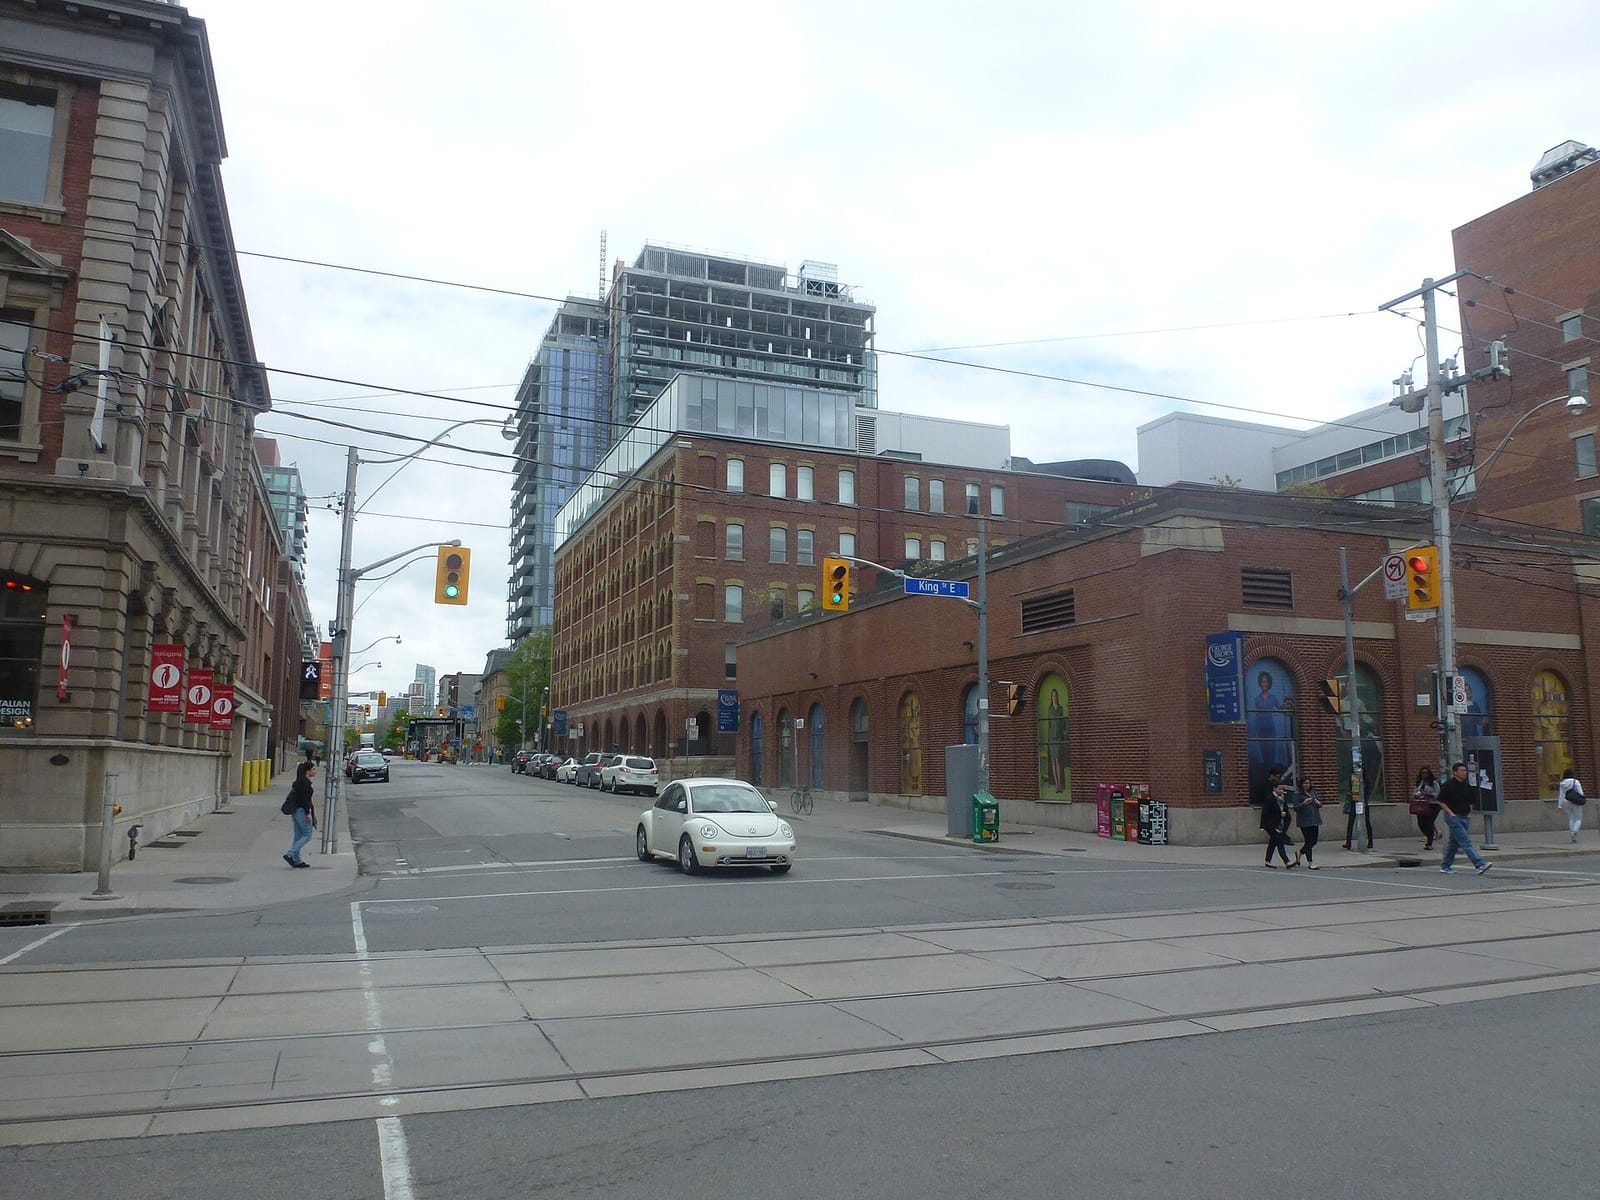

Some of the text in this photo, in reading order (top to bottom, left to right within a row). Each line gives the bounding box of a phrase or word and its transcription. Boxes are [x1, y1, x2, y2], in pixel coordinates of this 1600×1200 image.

[919, 580, 939, 594] King
[950, 583, 956, 593] E
[0, 707, 30, 715] ESIGN
